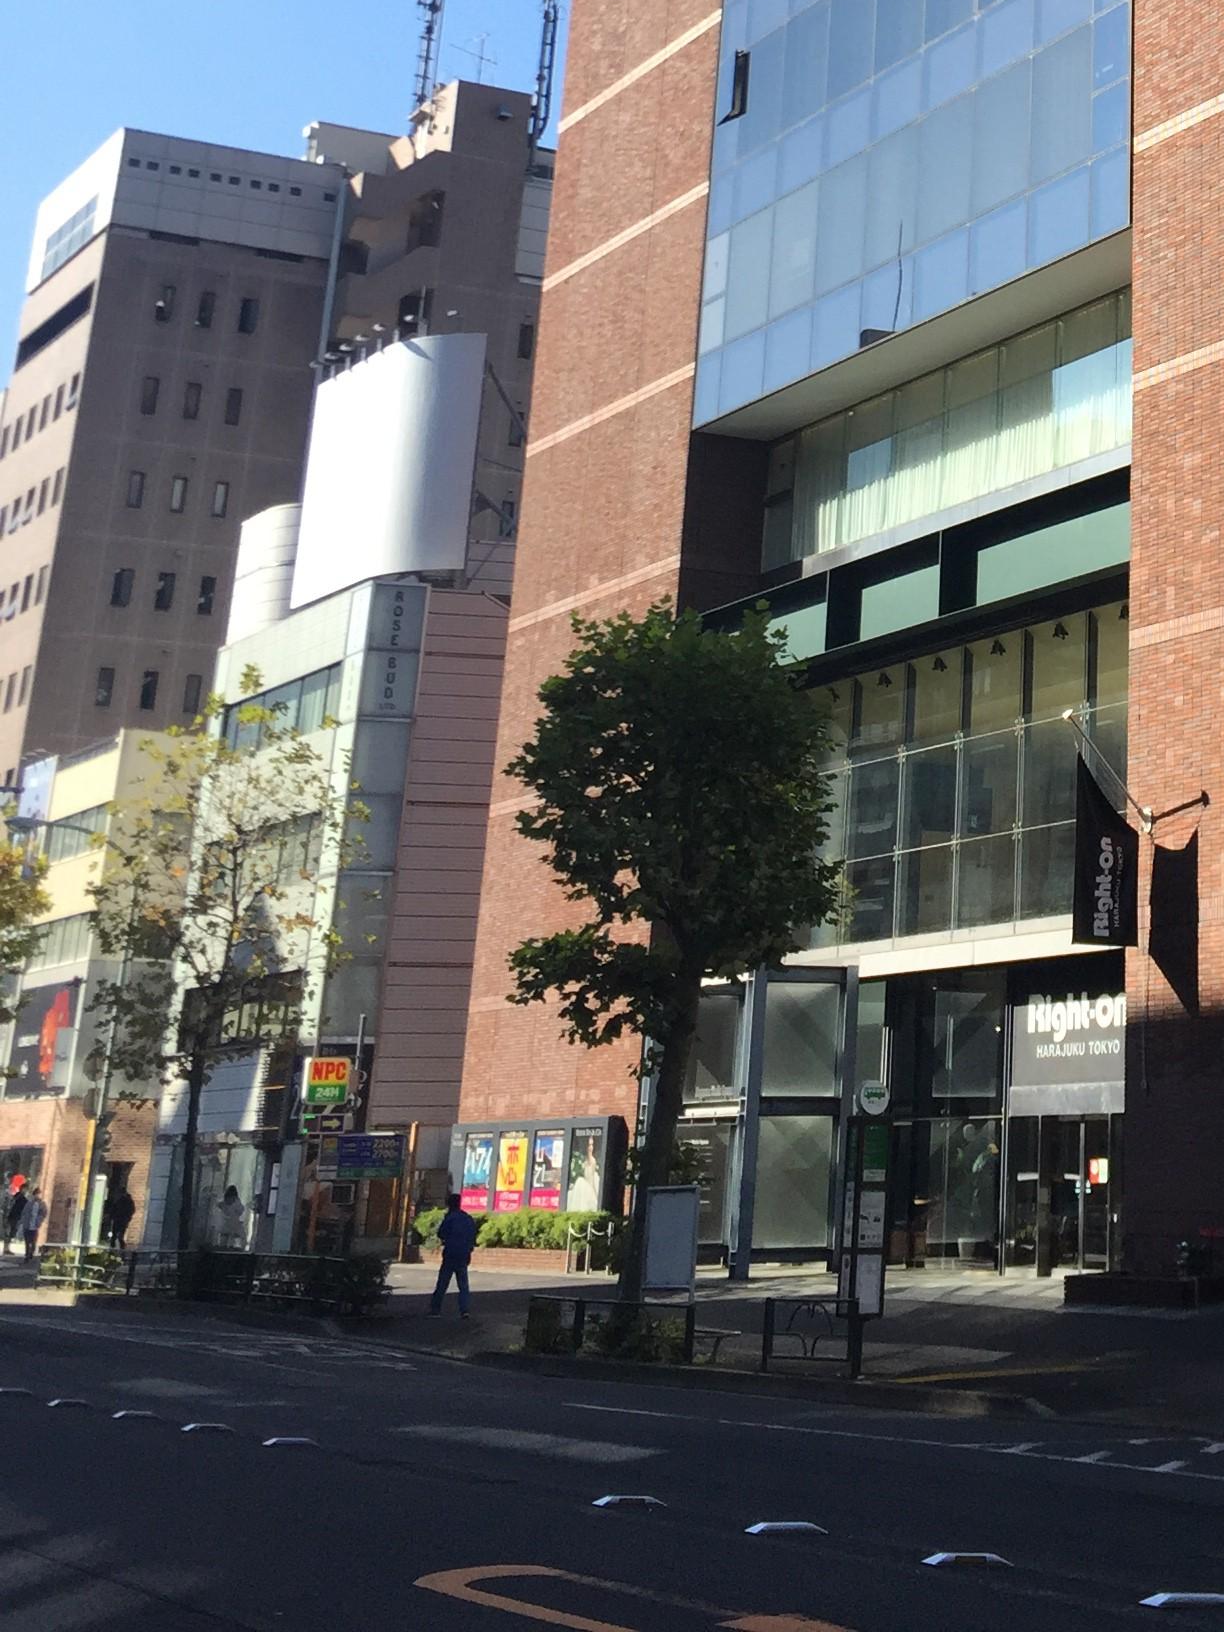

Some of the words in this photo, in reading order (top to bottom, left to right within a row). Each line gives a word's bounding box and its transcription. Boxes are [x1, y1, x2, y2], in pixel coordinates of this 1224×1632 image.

[391, 591, 404, 646] ROSE
[384, 656, 396, 699] BUD
[1093, 836, 1114, 937] Right-on
[1028, 992, 1127, 1043] Right-on
[312, 1062, 346, 1081] NPC
[1036, 1041, 1086, 1058] HARAJUKU
[1088, 1039, 1120, 1055] TOKYO
